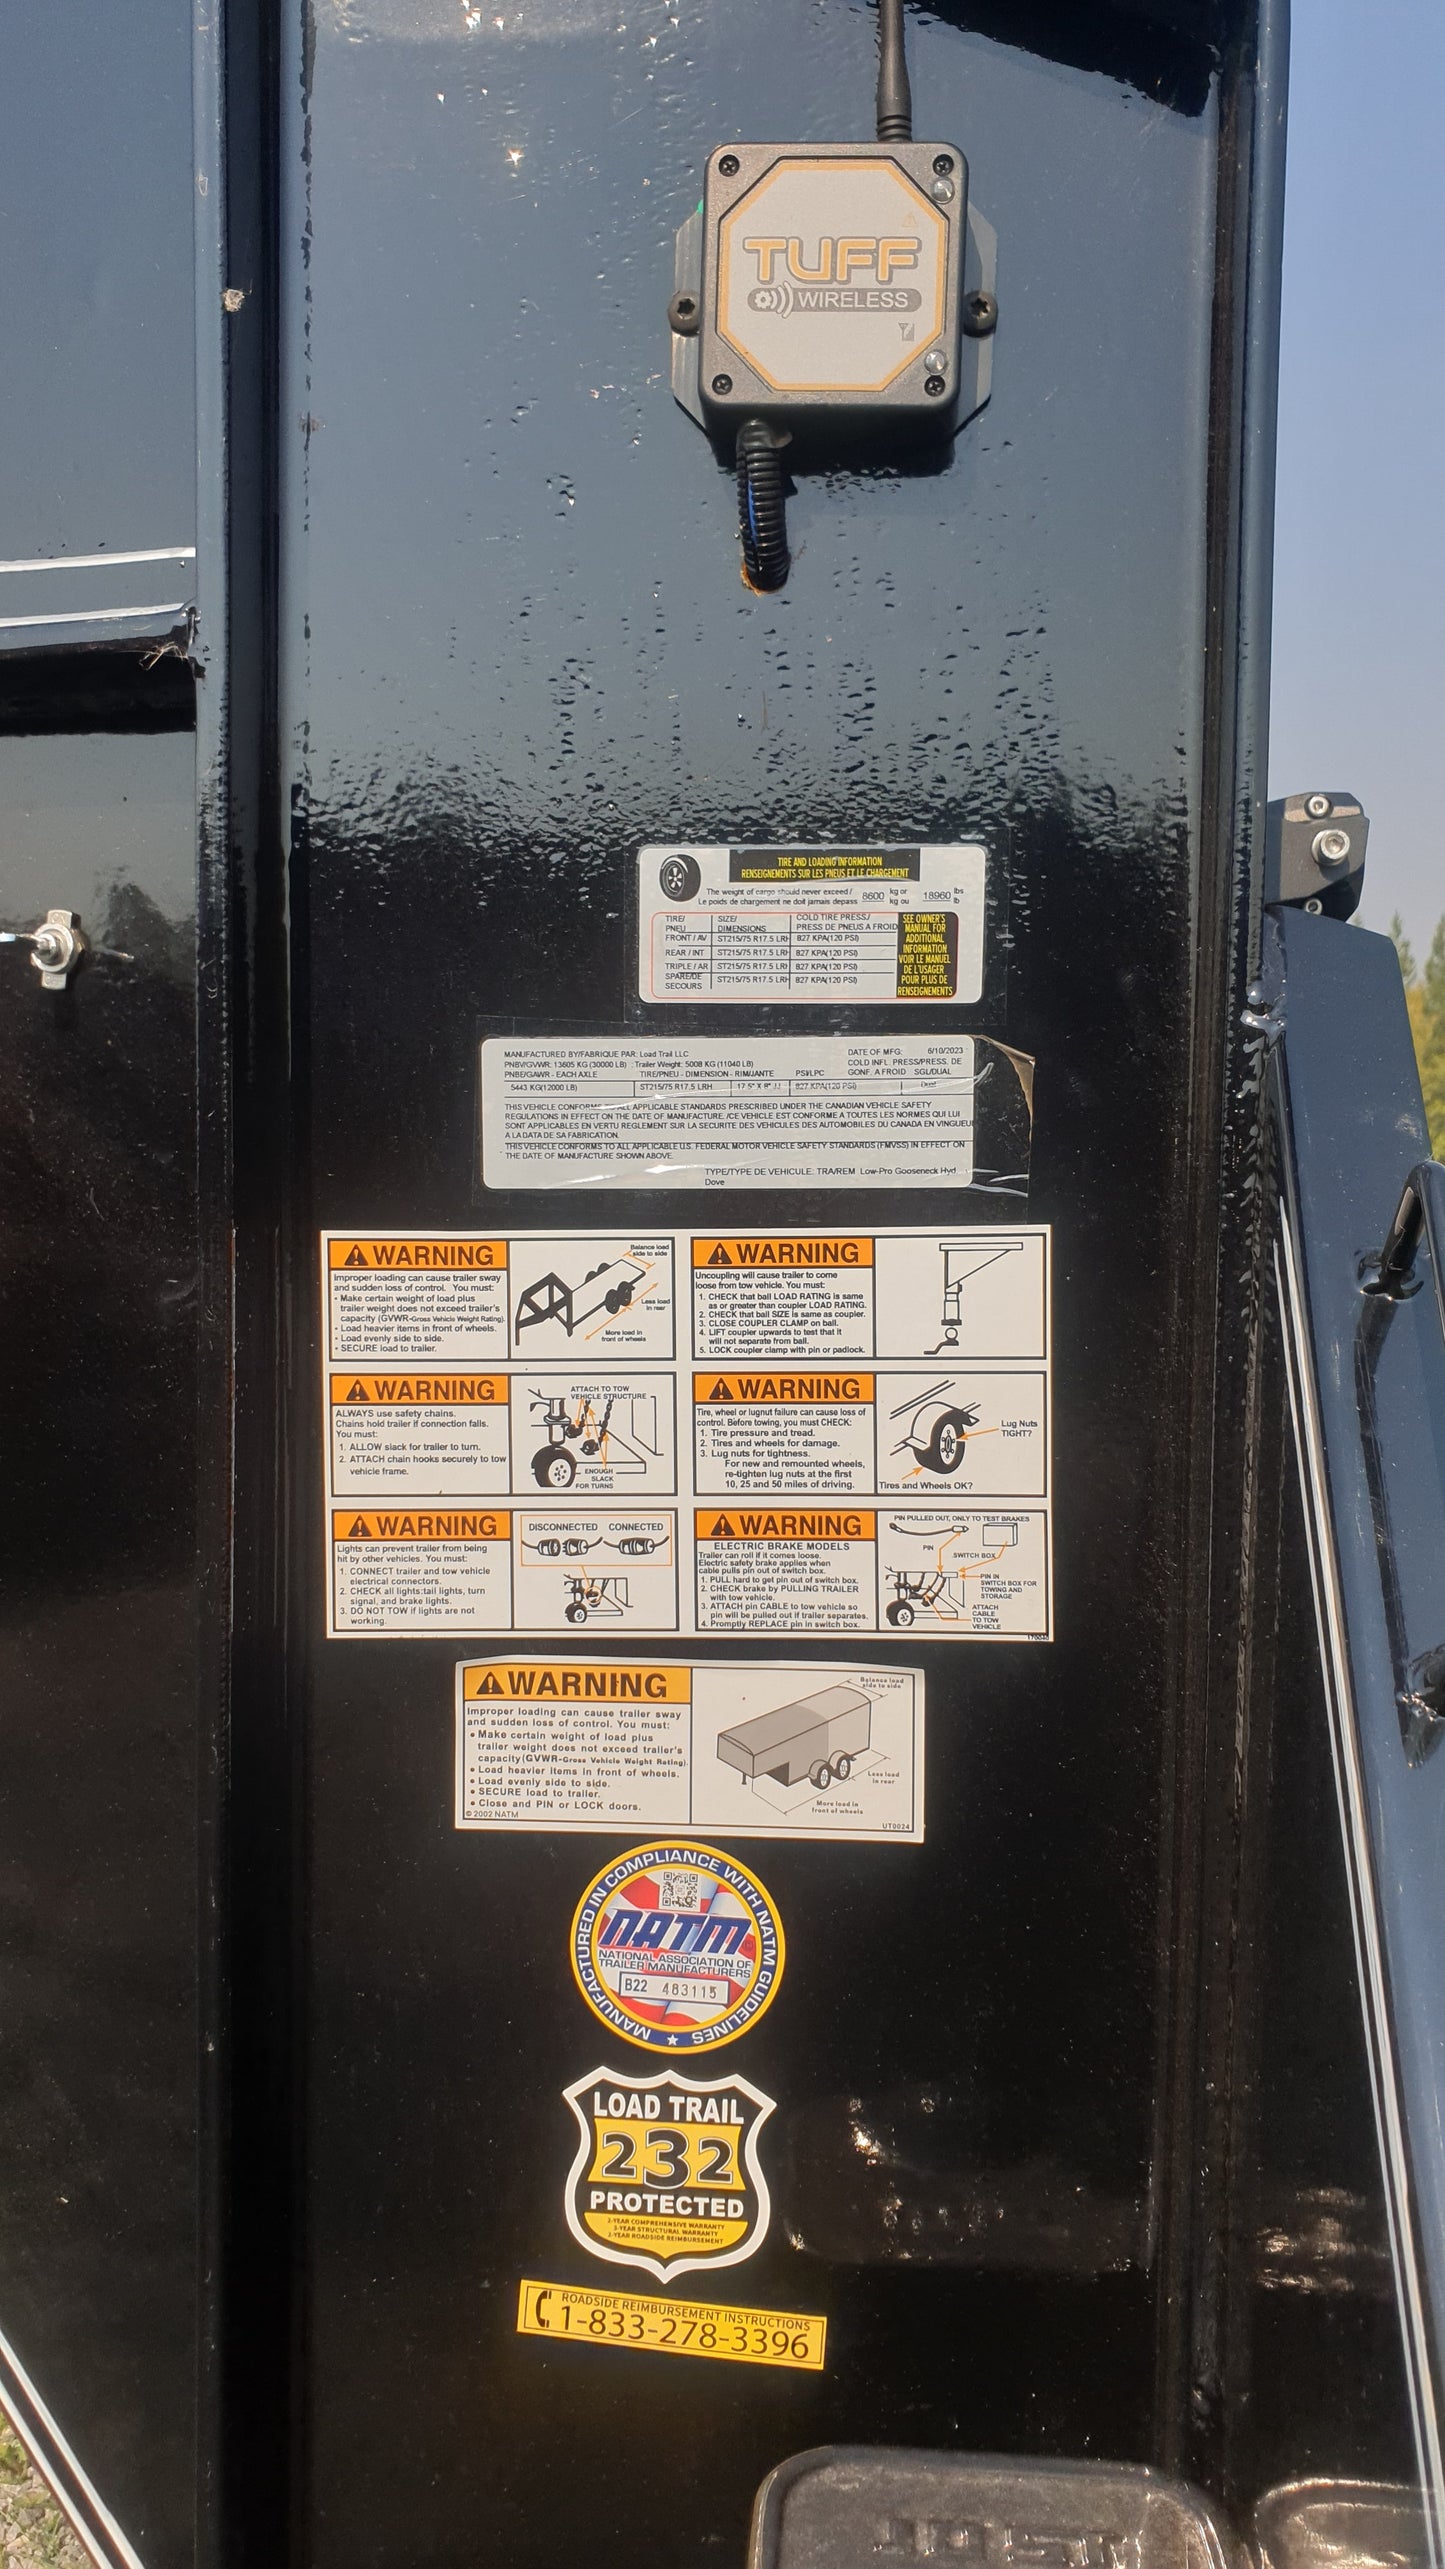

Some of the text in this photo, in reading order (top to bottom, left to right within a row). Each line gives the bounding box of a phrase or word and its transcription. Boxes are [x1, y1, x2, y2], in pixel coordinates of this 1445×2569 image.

[744, 237, 920, 282] TUFF
[798, 292, 909, 308] WIRELESS
[777, 857, 882, 866] TIRE AND LOADING INFORMATION
[741, 868, 909, 878] RENSEIGNEMENTS SUR LES PNEUS ET LE CHARGEMENT
[861, 891, 884, 900] 8600
[889, 888, 898, 896] kg
[923, 890, 952, 900] 18960
[902, 914, 945, 923] SEE OWNER'S
[904, 924, 946, 932] MANUAL FOR
[905, 934, 944, 943] ADDITIONAL
[902, 944, 947, 953] INFORMATION
[898, 954, 951, 963] VOIR LE MANUEL
[903, 965, 944, 973] DE L'USAGER
[901, 975, 947, 984] POUR PLUS DE
[897, 986, 953, 996] RENSEIGNEMENTS
[565, 1084, 577, 1092] LB)
[374, 1245, 493, 1265] WARNING
[736, 1243, 858, 1263] WARNING
[333, 1274, 372, 1283] Improper
[374, 1274, 406, 1283] loading
[478, 1275, 501, 1283] sway
[694, 1272, 740, 1281] Uncoupling
[781, 1272, 804, 1281] trailer
[340, 1344, 377, 1352] SECURE
[379, 1344, 398, 1352] load
[410, 1344, 436, 1352] trailer.
[374, 1380, 494, 1400] WARNING
[737, 1378, 859, 1399] WARNING
[335, 1409, 374, 1417] ALWAYS
[394, 1409, 422, 1419] safety
[424, 1409, 456, 1417] chains.
[1001, 1420, 1017, 1428] Lug
[1001, 1429, 1032, 1437] TIGHT?
[879, 1481, 973, 1490] Tires and Wheels OK?
[376, 1516, 496, 1536] WARNING
[528, 1523, 598, 1531] DISCONNECTED
[739, 1515, 861, 1535] WARNING
[714, 1542, 849, 1550] ELECTRIC BRAKE MODELS
[349, 1567, 393, 1575] CONNECT
[508, 1671, 666, 1698] WARNING
[466, 1706, 681, 1722] Improper loading can cause trailer sway
[478, 1799, 507, 1807] Close
[512, 1799, 530, 1808] and
[536, 1800, 553, 1808] PIN
[574, 1800, 603, 1809] LOCK
[608, 1802, 641, 1810] doors.
[599, 1909, 752, 1955] NATM
[578, 1849, 776, 2044] MANUFACTURED IN COMPLIANCE WITH NATM GUIDELINES
[598, 1950, 751, 1968] NATIONAL ASSOCIATION OF
[598, 1959, 751, 1978] TRAILER MANUFACTURERS
[624, 1978, 716, 1999] B22 483115
[593, 2091, 744, 2125] LOAD TRAIL
[602, 2128, 733, 2190] 232
[590, 2191, 743, 2219] PROTECTED
[630, 2219, 686, 2227] COMPREHENSIVE
[666, 2236, 722, 2244] REIMBURSEMENT
[561, 2292, 810, 2331] ROADSIDE REIMBURSEMENT INSTRUCTIONS
[562, 2305, 809, 2359] 1-833-278-3396
